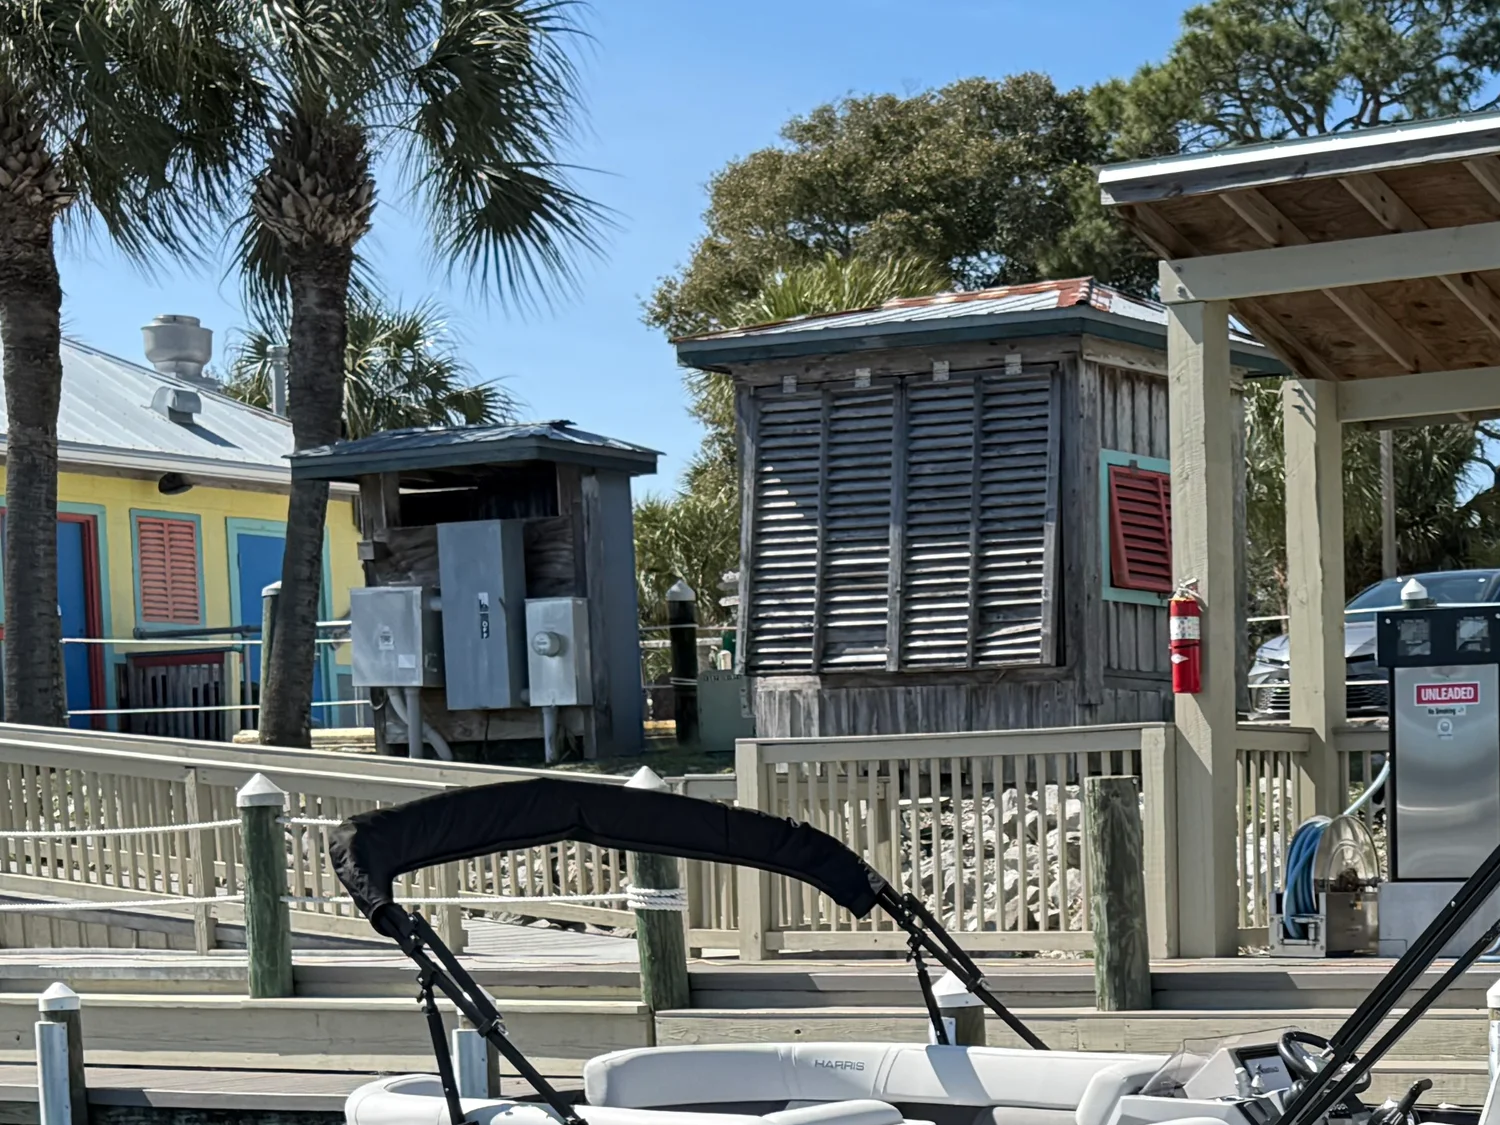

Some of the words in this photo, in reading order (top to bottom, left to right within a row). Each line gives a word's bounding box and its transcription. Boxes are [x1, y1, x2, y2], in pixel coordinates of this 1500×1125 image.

[1421, 686, 1475, 701] UNLEADED
[1436, 707, 1456, 715] Smoking
[814, 1059, 866, 1071] HARRIS
